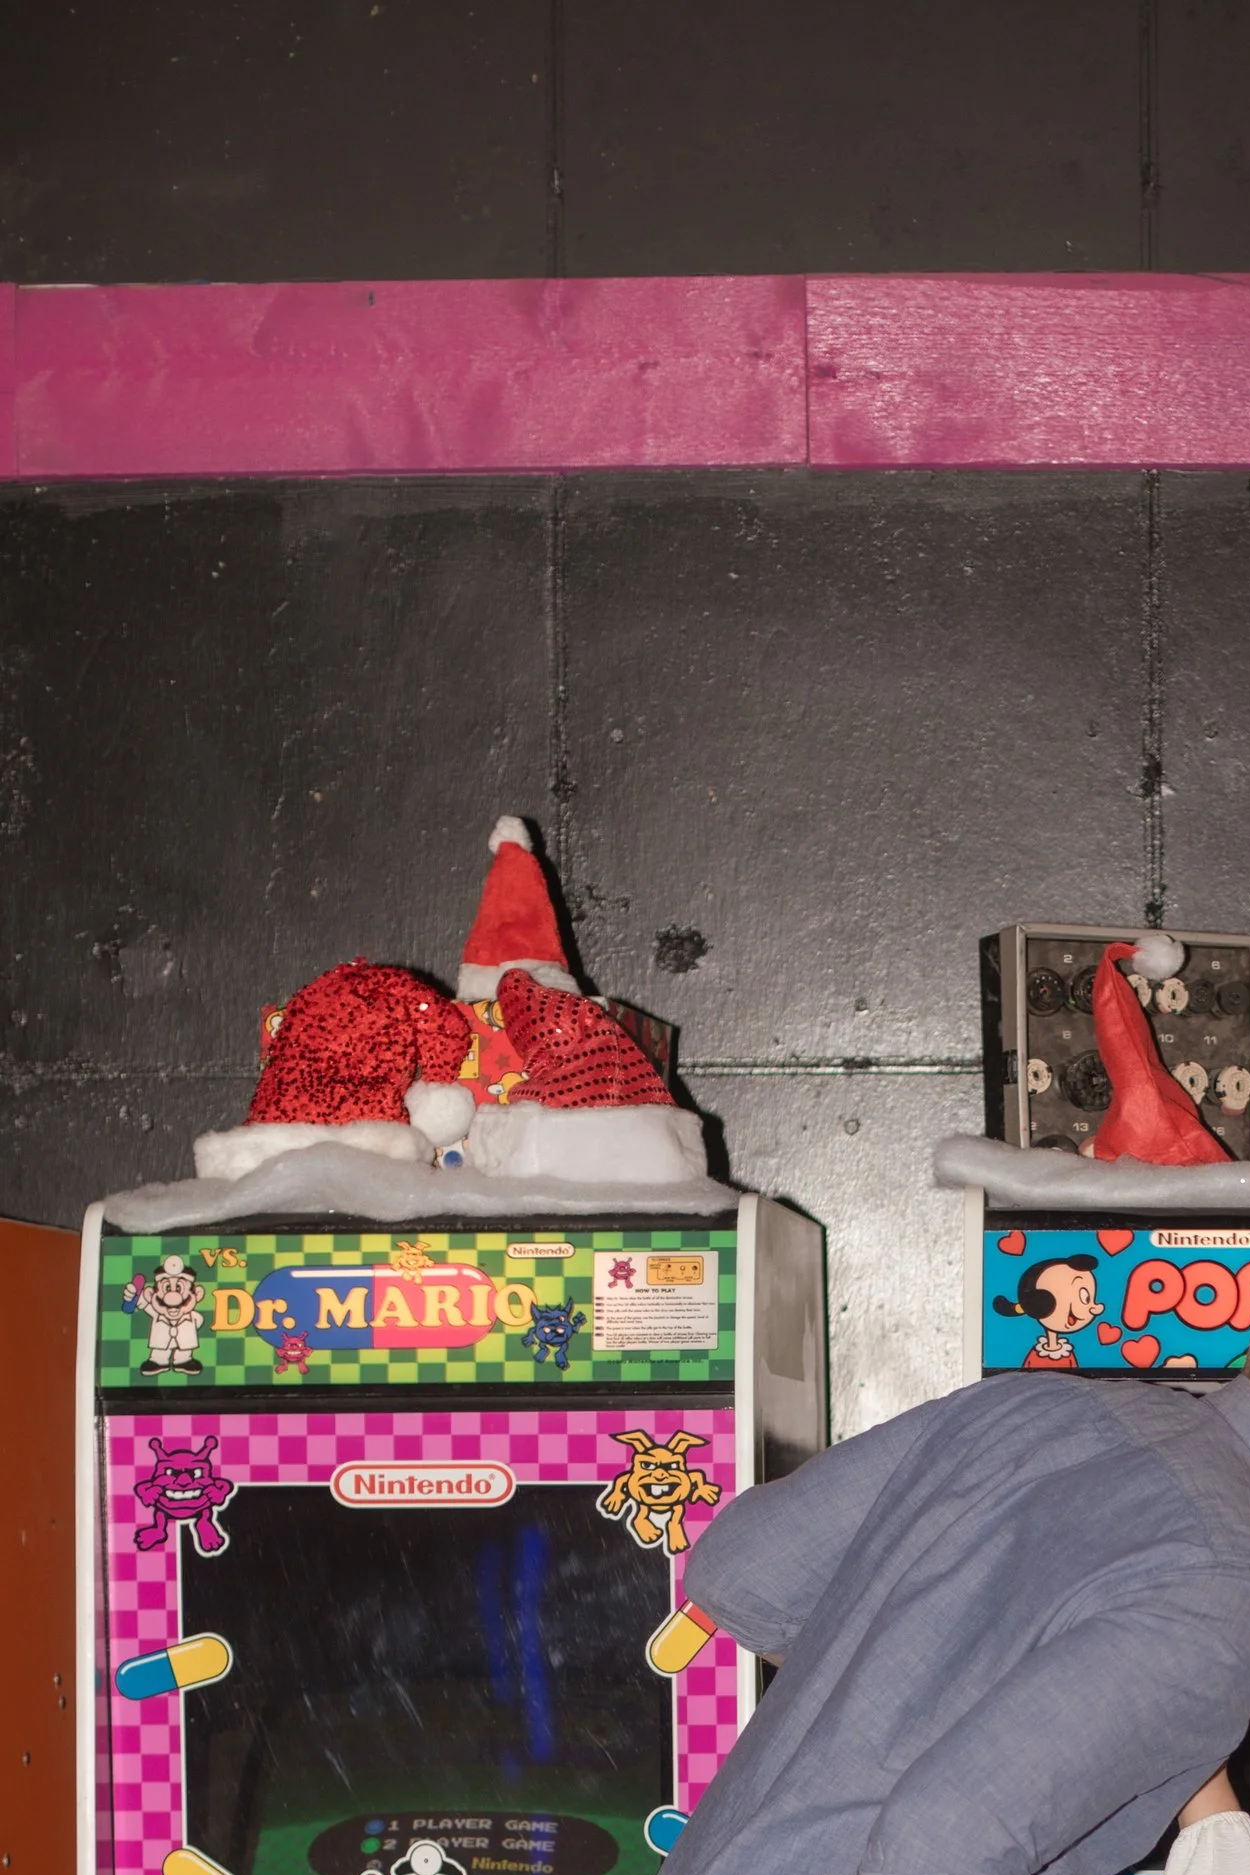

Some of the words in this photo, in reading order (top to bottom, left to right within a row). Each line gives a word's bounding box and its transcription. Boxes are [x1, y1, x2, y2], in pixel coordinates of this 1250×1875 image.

[1063, 954, 1073, 963] 2
[1159, 1033, 1174, 1043] 10
[1203, 1035, 1218, 1045] 11
[1073, 1122, 1089, 1132] 13
[1158, 1232, 1250, 1246] Nintendo
[513, 1246, 570, 1256] Nintendo
[211, 1287, 296, 1331] Dr.
[313, 1283, 538, 1331] MARIO
[388, 1821, 400, 1831] 1
[412, 1818, 493, 1831] PLAYER
[505, 1819, 558, 1833] GAME
[383, 1838, 397, 1850] 2
[409, 1837, 489, 1849] AYER
[502, 1838, 556, 1852] GAME
[471, 1856, 554, 1874] Nintendo
